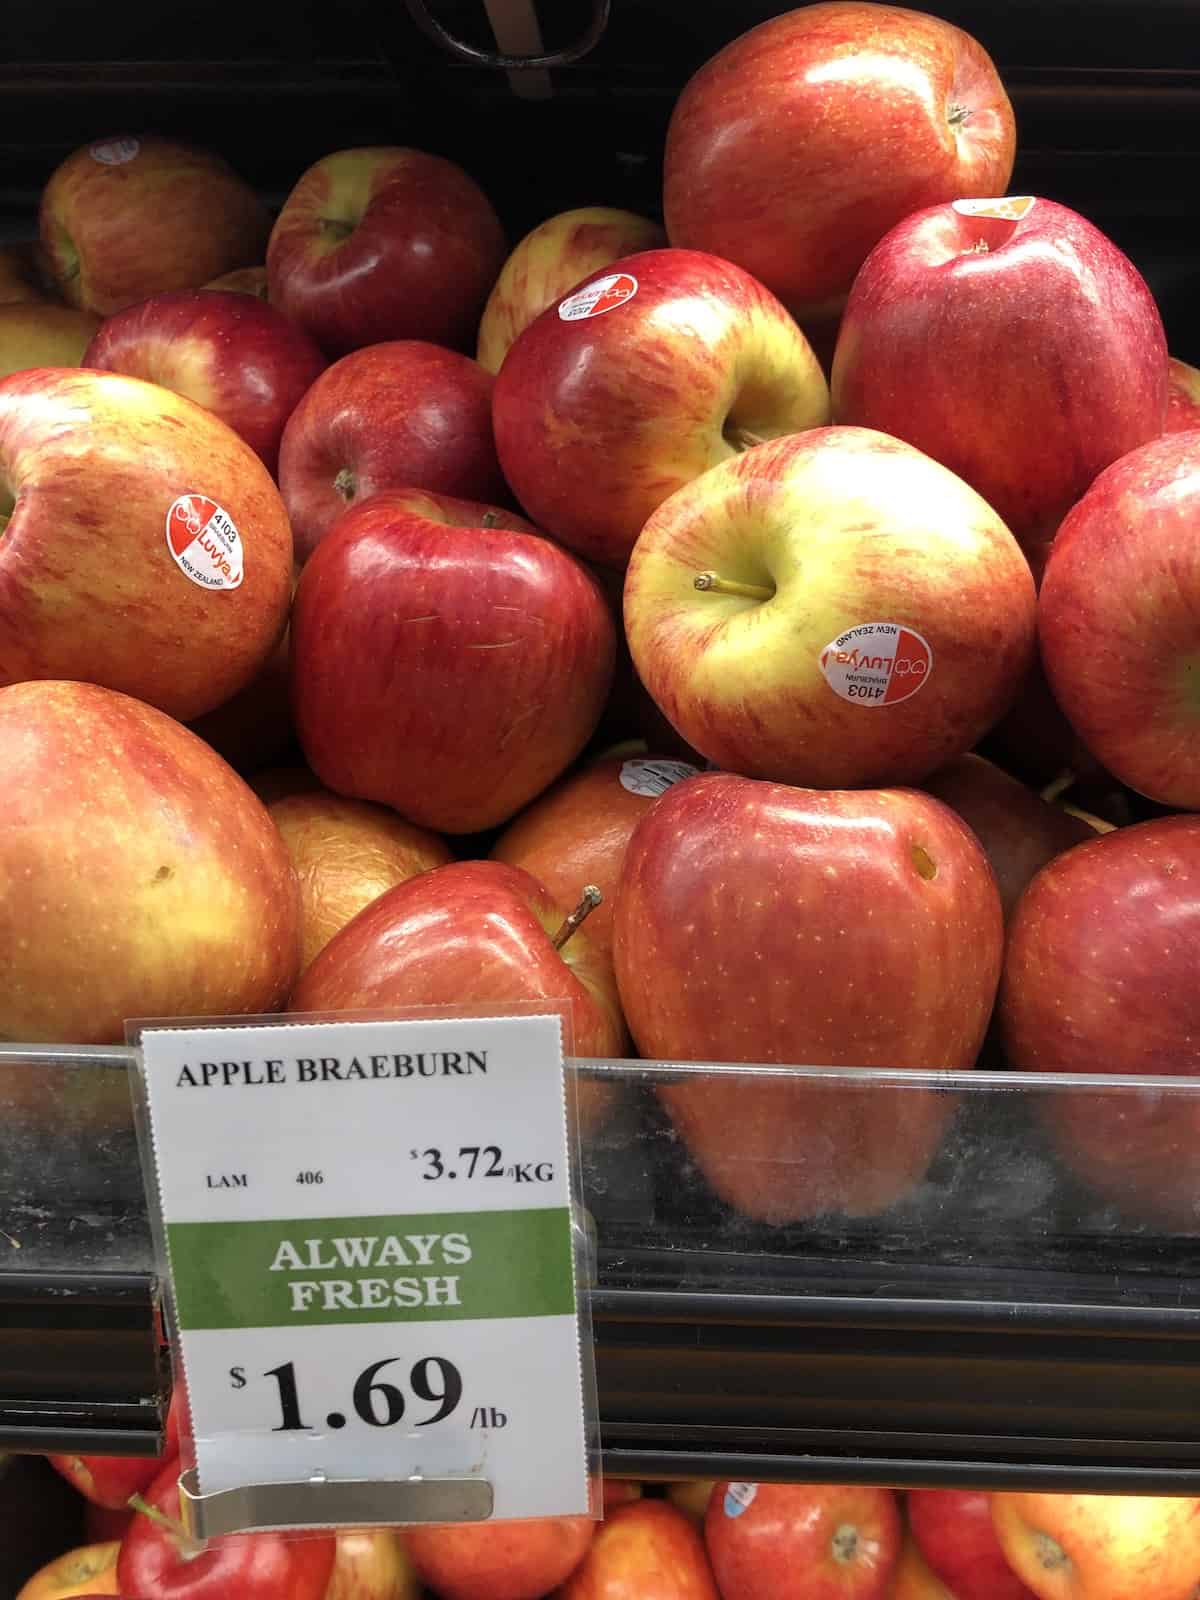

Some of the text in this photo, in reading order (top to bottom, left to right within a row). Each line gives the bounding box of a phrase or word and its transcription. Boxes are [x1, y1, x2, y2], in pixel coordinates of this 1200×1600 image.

[214, 514, 237, 543] 4103
[180, 556, 224, 586] NEW ZEALAND
[836, 626, 897, 647] NEW ZEALAND
[847, 685, 885, 698] 4103
[175, 1050, 489, 1087] APPLE BRAEBURN
[206, 1171, 324, 1189] LAM 406
[269, 1233, 473, 1271] ALWAYS
[288, 1275, 462, 1311] FRESH
